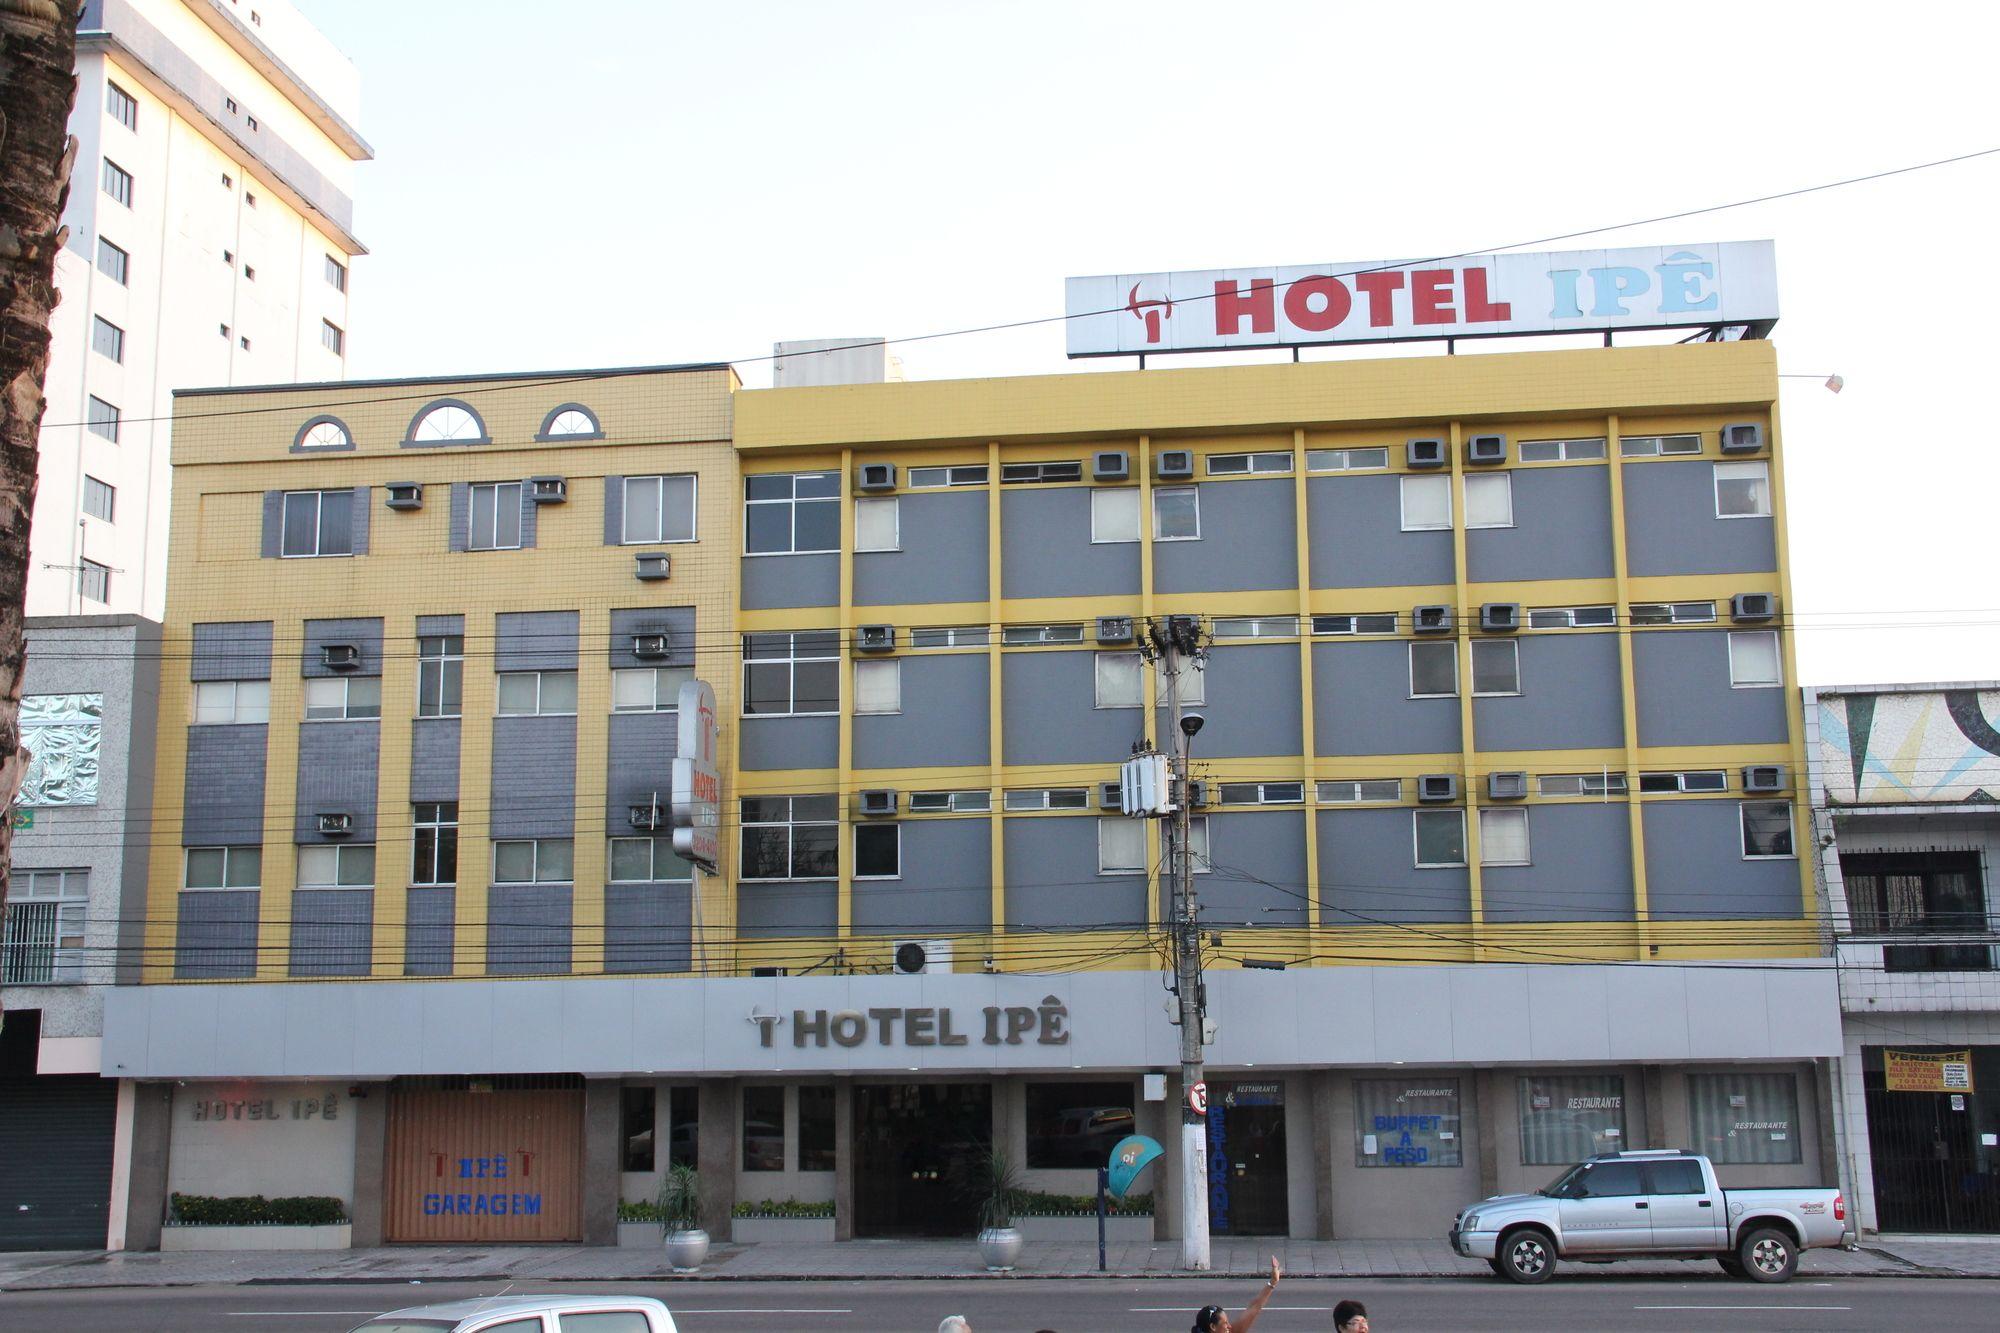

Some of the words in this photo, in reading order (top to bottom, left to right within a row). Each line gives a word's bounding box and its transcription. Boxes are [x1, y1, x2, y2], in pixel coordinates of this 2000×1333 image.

[1215, 267, 1511, 335] HOTEL
[1547, 251, 1718, 319] IPÊ
[694, 771, 718, 804] HOTEL
[793, 1007, 968, 1047] HOTEL
[982, 994, 1069, 1045] IPÊ
[1236, 1085, 1278, 1093] RESTAURANTE
[1405, 1088, 1453, 1097] RESTAURANTE
[192, 1099, 280, 1121] HOTEL
[291, 1091, 338, 1121] IPÊ
[1568, 1096, 1621, 1109] RESTAURANTE
[1375, 1114, 1441, 1131] BUFFET
[1400, 1131, 1412, 1147] A
[1122, 1151, 1134, 1164] oi
[1384, 1147, 1428, 1163] PESO
[459, 1154, 507, 1178] IPÊ
[423, 1194, 541, 1216] GARAGEM
